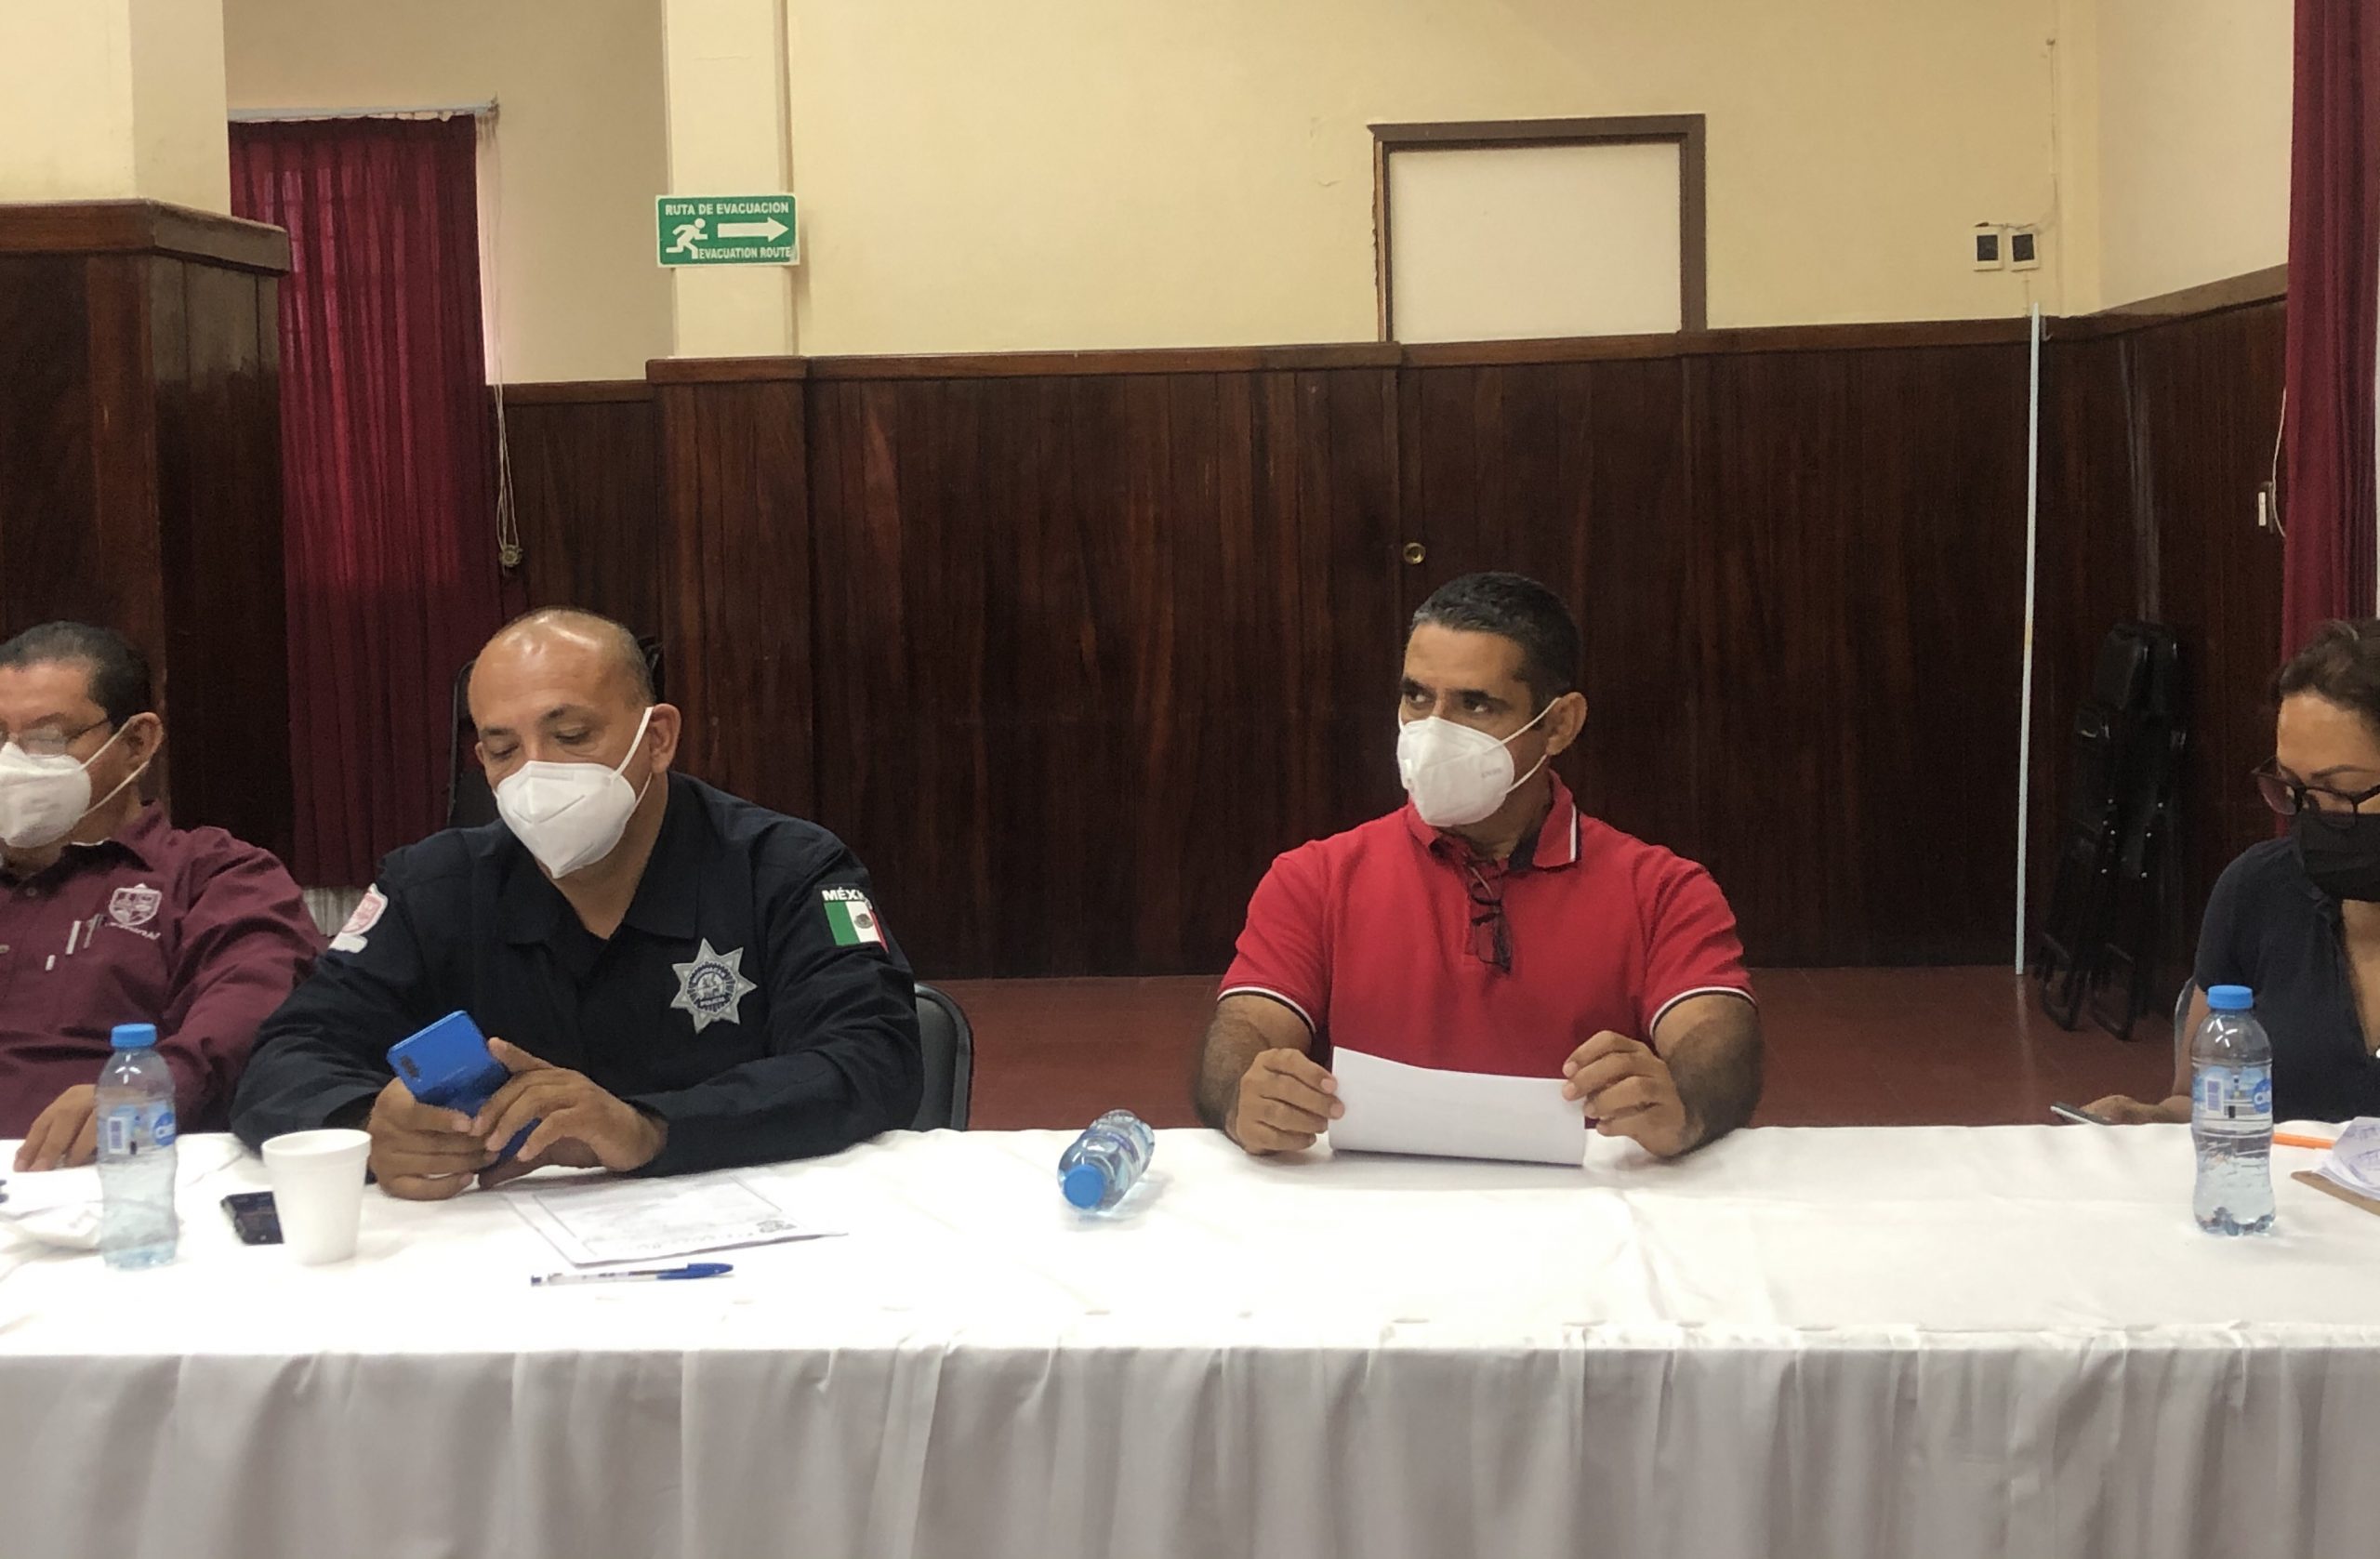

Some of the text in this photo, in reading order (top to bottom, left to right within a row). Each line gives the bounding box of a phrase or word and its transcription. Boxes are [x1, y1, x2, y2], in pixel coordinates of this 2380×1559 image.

[665, 202, 789, 216] RUTA DE EVACUACION
[699, 246, 791, 259] EVACUATION ROUTE
